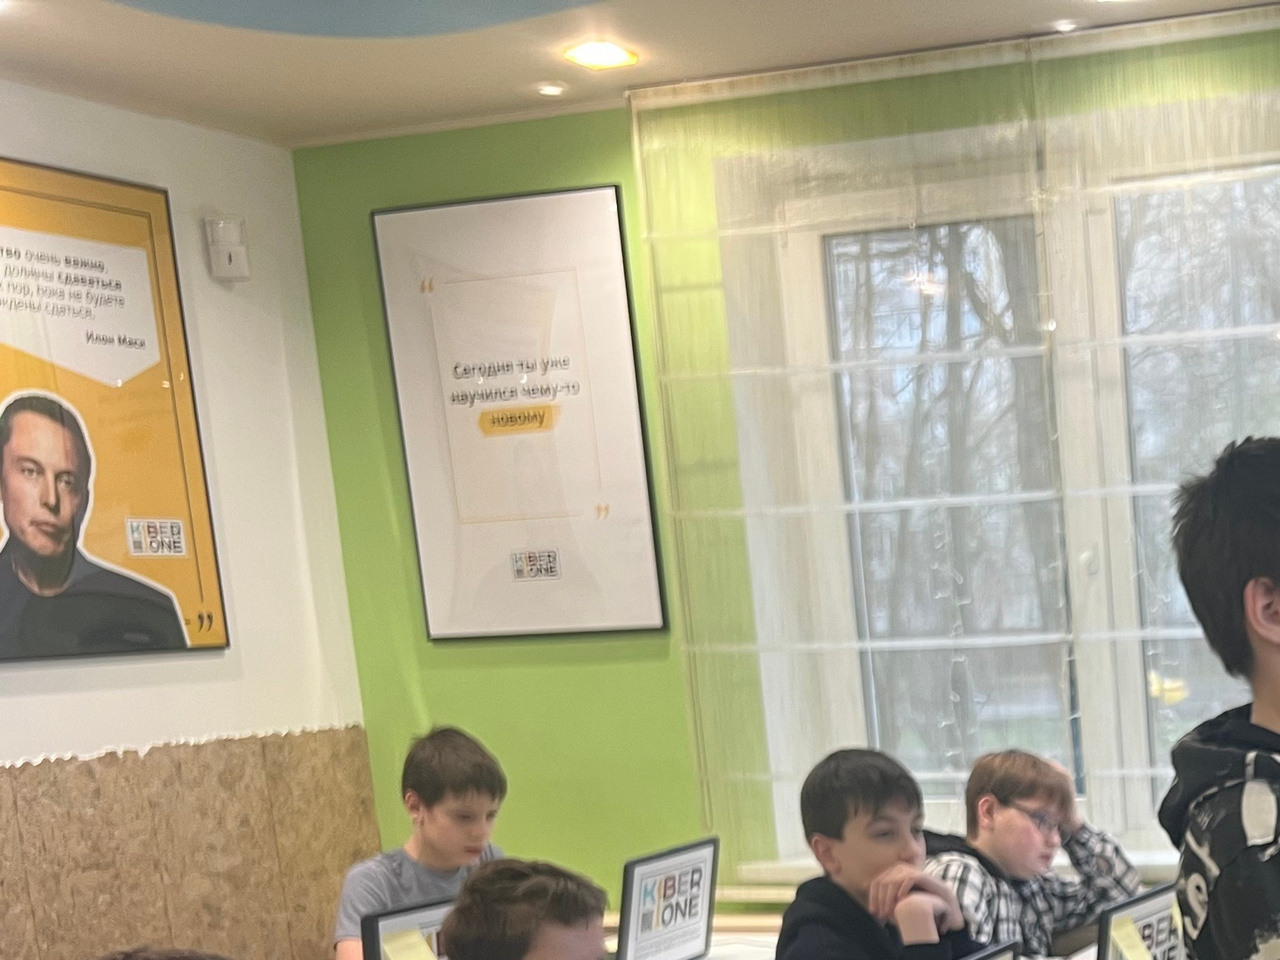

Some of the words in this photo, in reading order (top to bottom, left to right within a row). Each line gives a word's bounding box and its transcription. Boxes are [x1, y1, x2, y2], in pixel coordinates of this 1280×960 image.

[86, 329, 115, 347] Илон
[453, 360, 514, 379] Сегодня
[516, 358, 538, 374] ты
[541, 355, 571, 376] уже
[450, 386, 518, 408] научился
[522, 381, 580, 401] чему-то
[491, 411, 545, 428] новому
[149, 540, 183, 553] ONE
[662, 898, 699, 927] ONE
